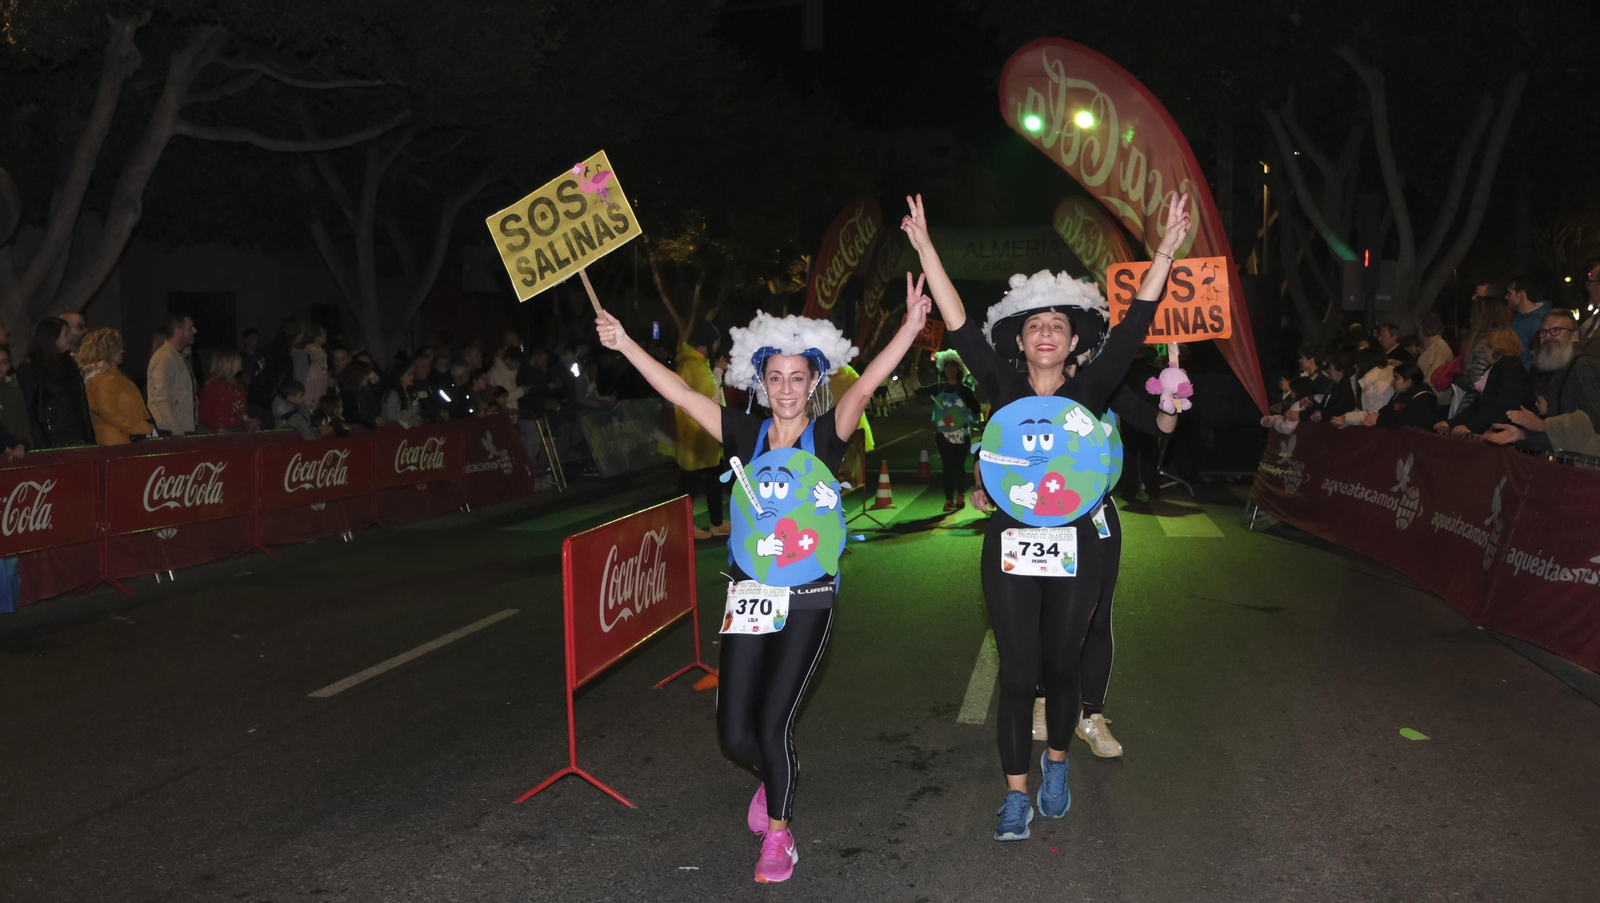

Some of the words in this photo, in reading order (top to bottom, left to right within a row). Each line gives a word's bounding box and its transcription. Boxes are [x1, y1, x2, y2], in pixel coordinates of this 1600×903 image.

[499, 179, 588, 253] SOS
[515, 202, 630, 288] SALINAS
[815, 202, 877, 309] Coca-Cola
[963, 236, 1062, 259] ALMERÍA
[963, 261, 1014, 273] CIUDAD
[1114, 265, 1195, 305] SS
[1117, 305, 1225, 336] LINAS
[283, 449, 351, 493] Coca-Cola
[394, 436, 447, 474] Coca-Cola
[143, 461, 228, 512] Coca-Cola
[1018, 541, 1060, 557] 734
[599, 525, 669, 633] Coca-Cola
[735, 598, 773, 615] 370
